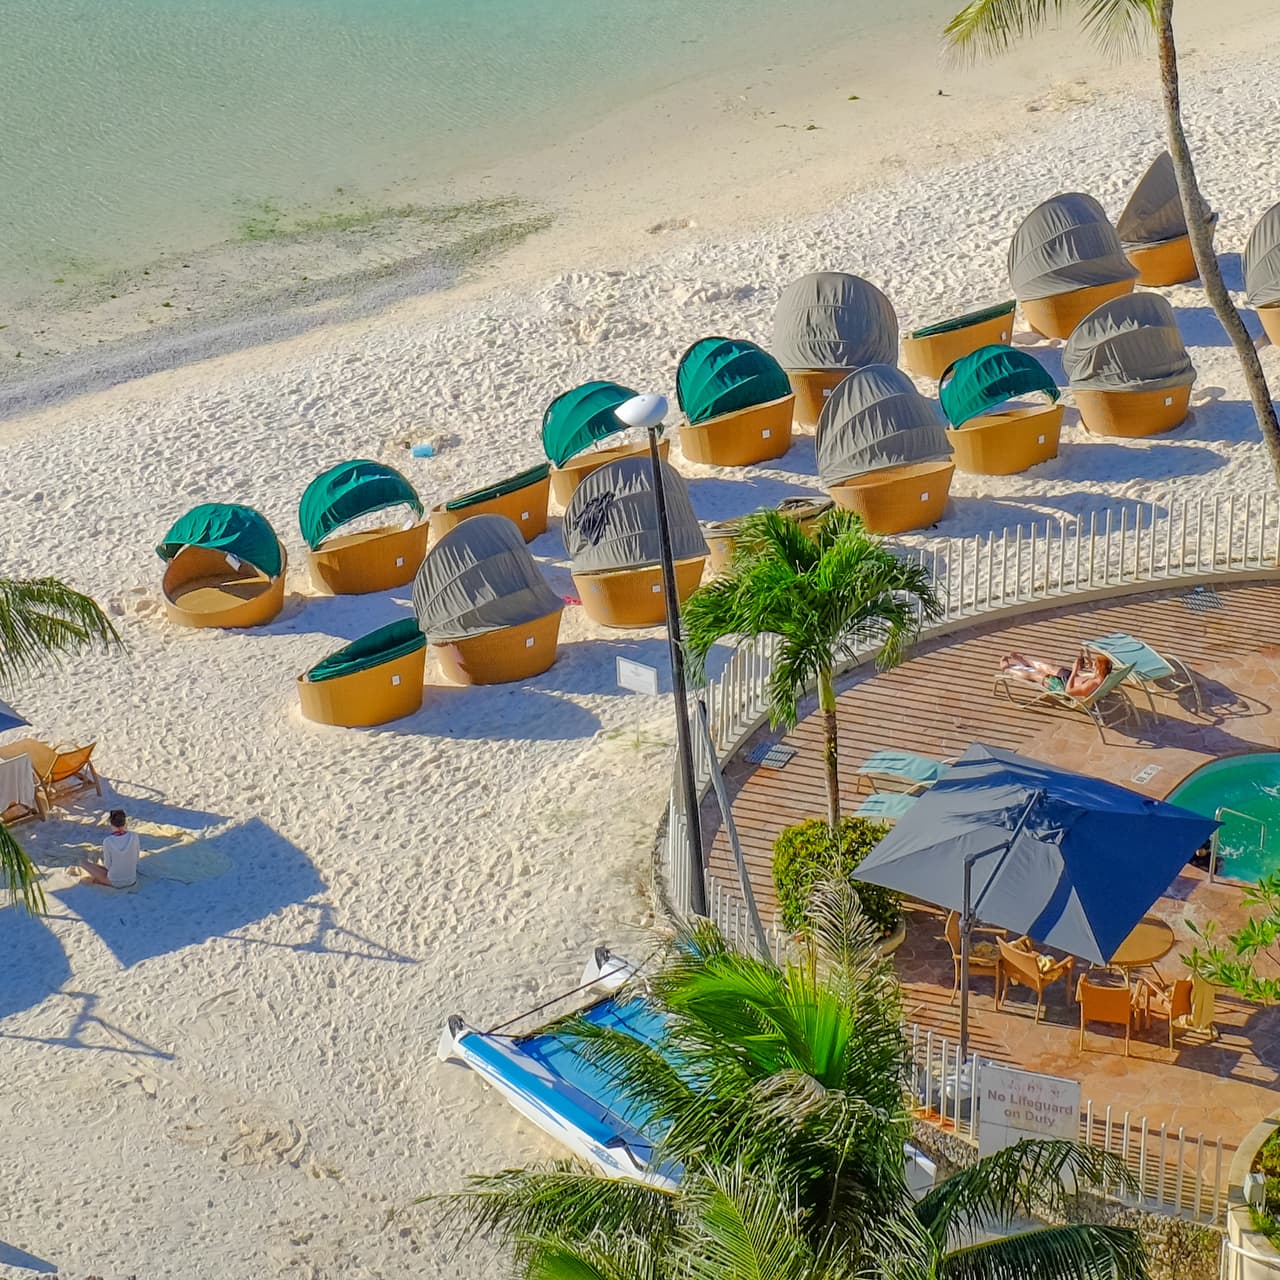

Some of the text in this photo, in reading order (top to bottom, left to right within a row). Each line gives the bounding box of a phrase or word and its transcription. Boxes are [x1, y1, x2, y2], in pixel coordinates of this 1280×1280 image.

[988, 1089, 1073, 1115] No Lifeguard
[1004, 1109, 1056, 1126] on Duty
